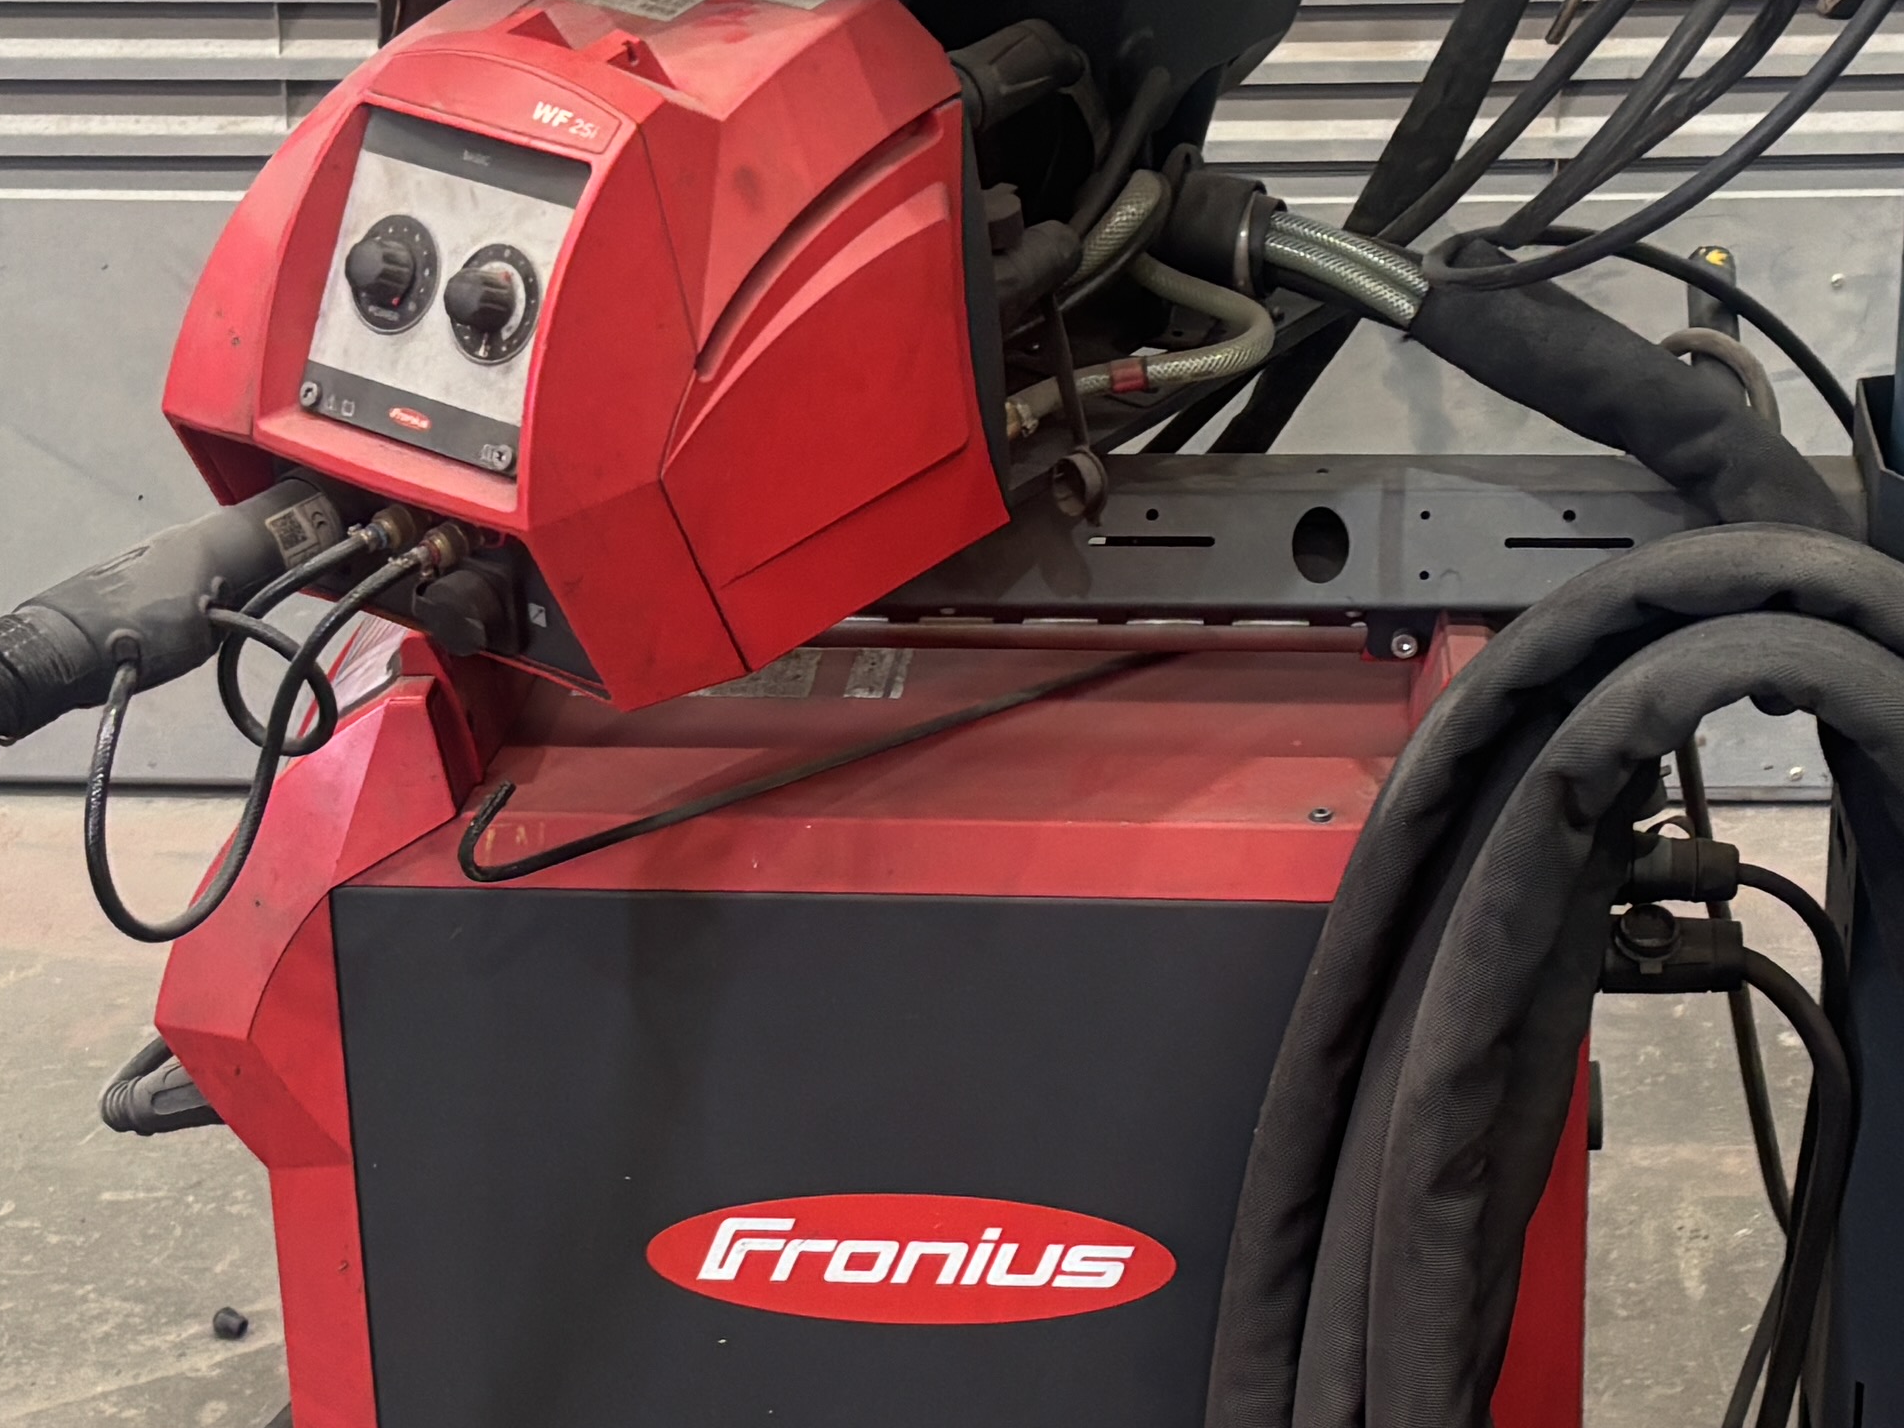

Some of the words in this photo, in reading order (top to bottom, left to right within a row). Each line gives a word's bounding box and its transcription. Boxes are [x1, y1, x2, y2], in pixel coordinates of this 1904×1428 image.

[532, 100, 574, 128] WF
[568, 118, 601, 140] 25i
[697, 1217, 1136, 1289] Fronius
